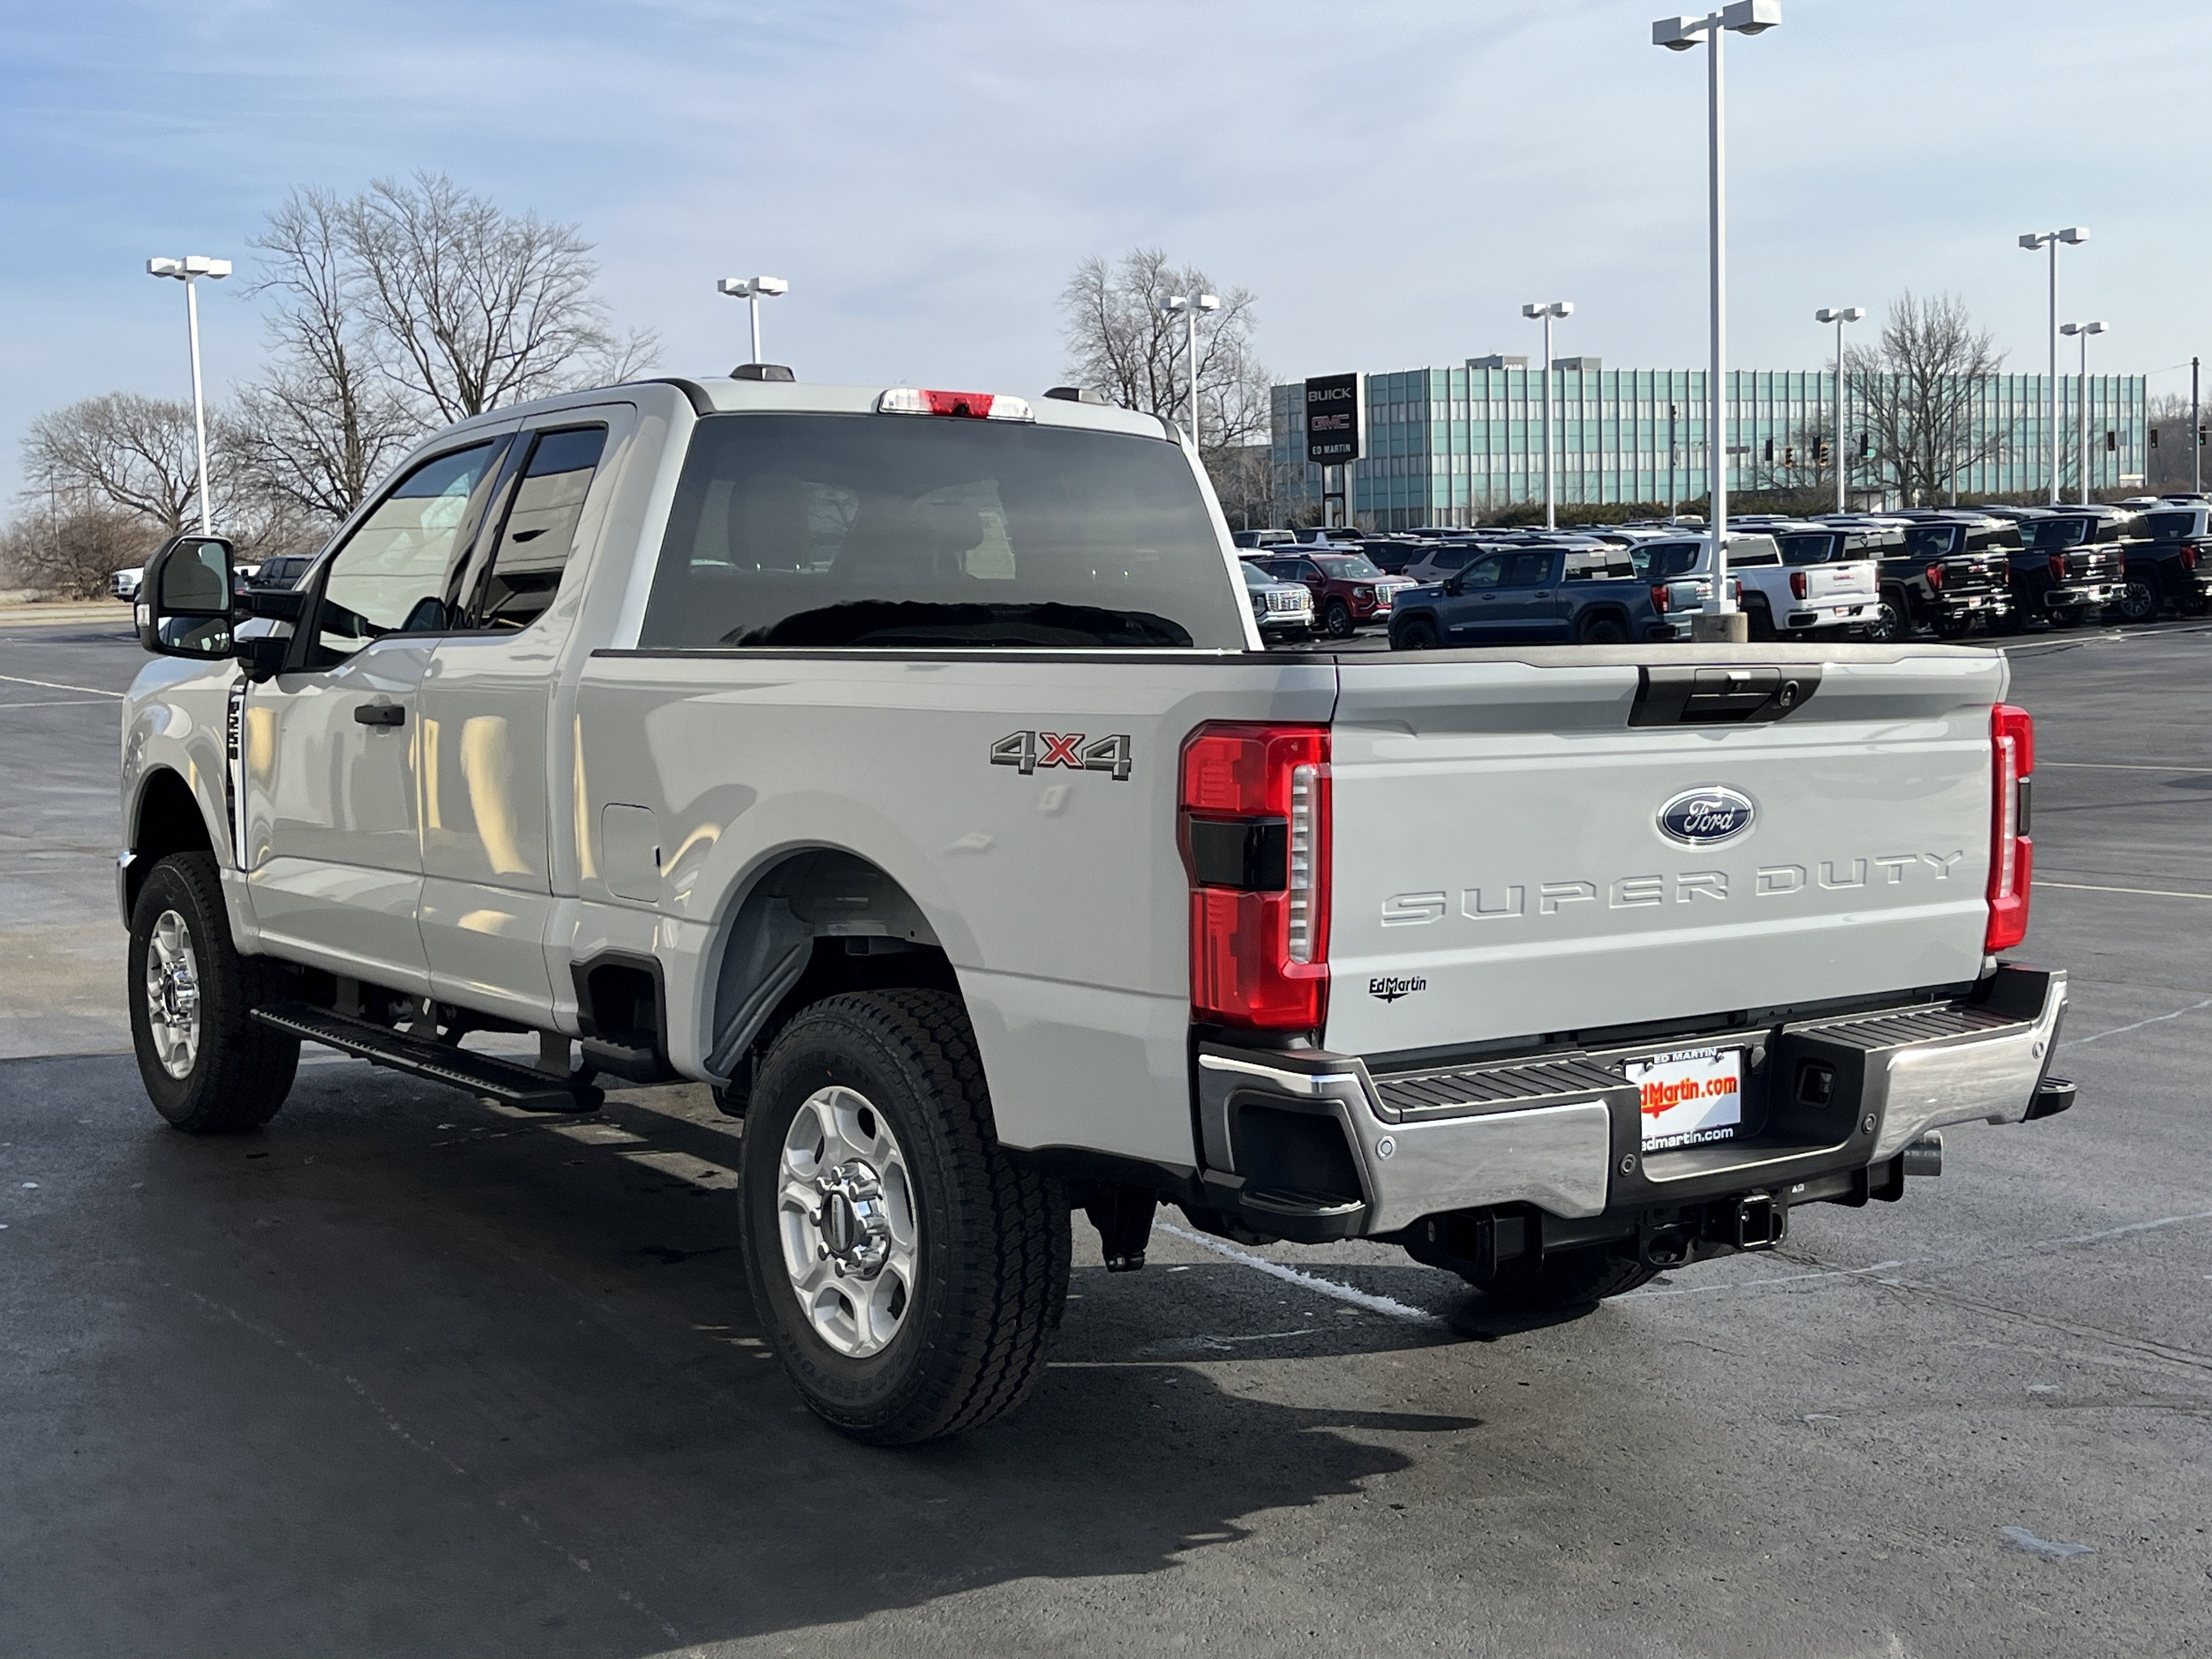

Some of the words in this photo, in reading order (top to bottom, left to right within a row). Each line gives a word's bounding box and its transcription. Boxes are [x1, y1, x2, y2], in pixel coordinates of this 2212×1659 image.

[1308, 387, 1351, 402] BUICK
[1312, 414, 1350, 431] GMC
[1312, 446, 1322, 455] ED
[1324, 444, 1351, 454] MARTIN
[1684, 800, 1736, 833] Ford
[1381, 870, 1729, 927] SUPER
[1756, 850, 1963, 896] DUTY
[1654, 1054, 1669, 1064] ED
[1673, 1048, 1717, 1061] MARTIN
[1640, 1076, 1737, 1106] dMartin.com
